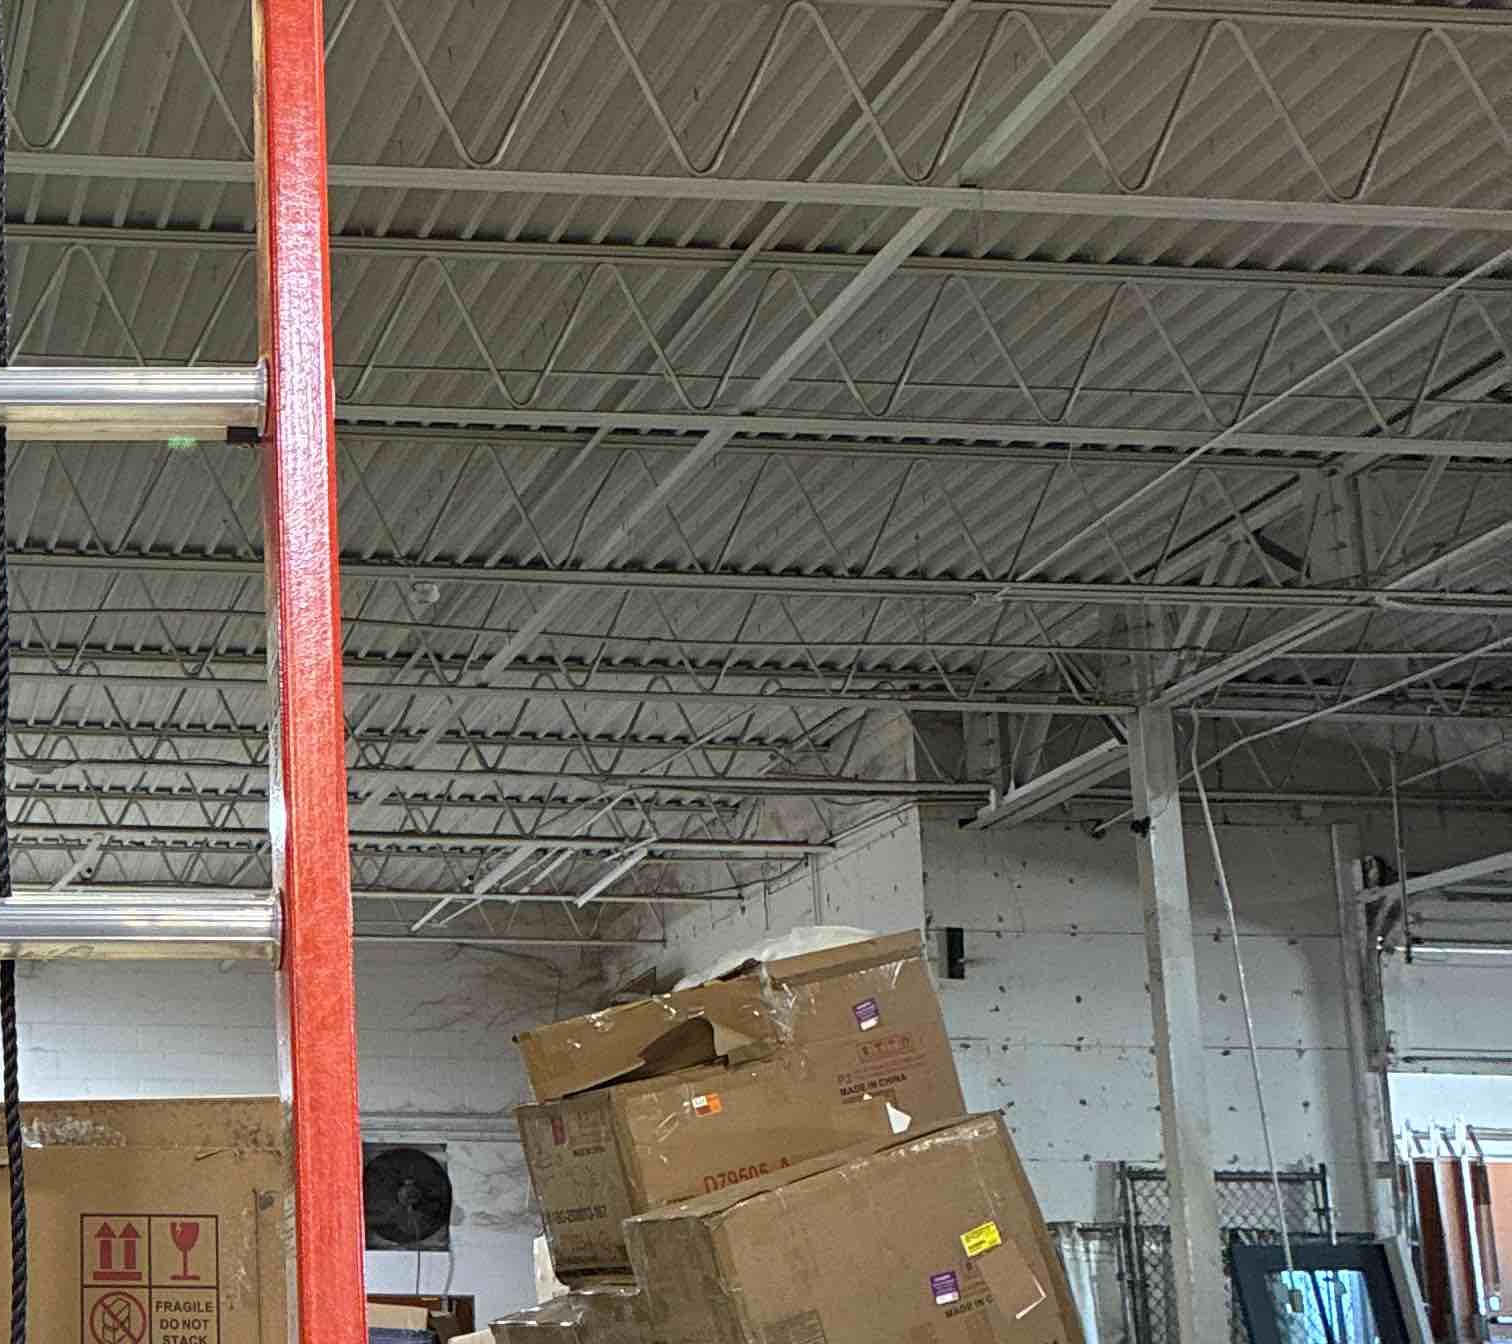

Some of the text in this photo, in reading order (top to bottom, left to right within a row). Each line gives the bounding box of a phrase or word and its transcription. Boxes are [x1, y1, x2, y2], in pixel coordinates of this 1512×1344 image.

[155, 1300, 214, 1314] FRAGILE
[159, 1318, 209, 1331] DO NOT
